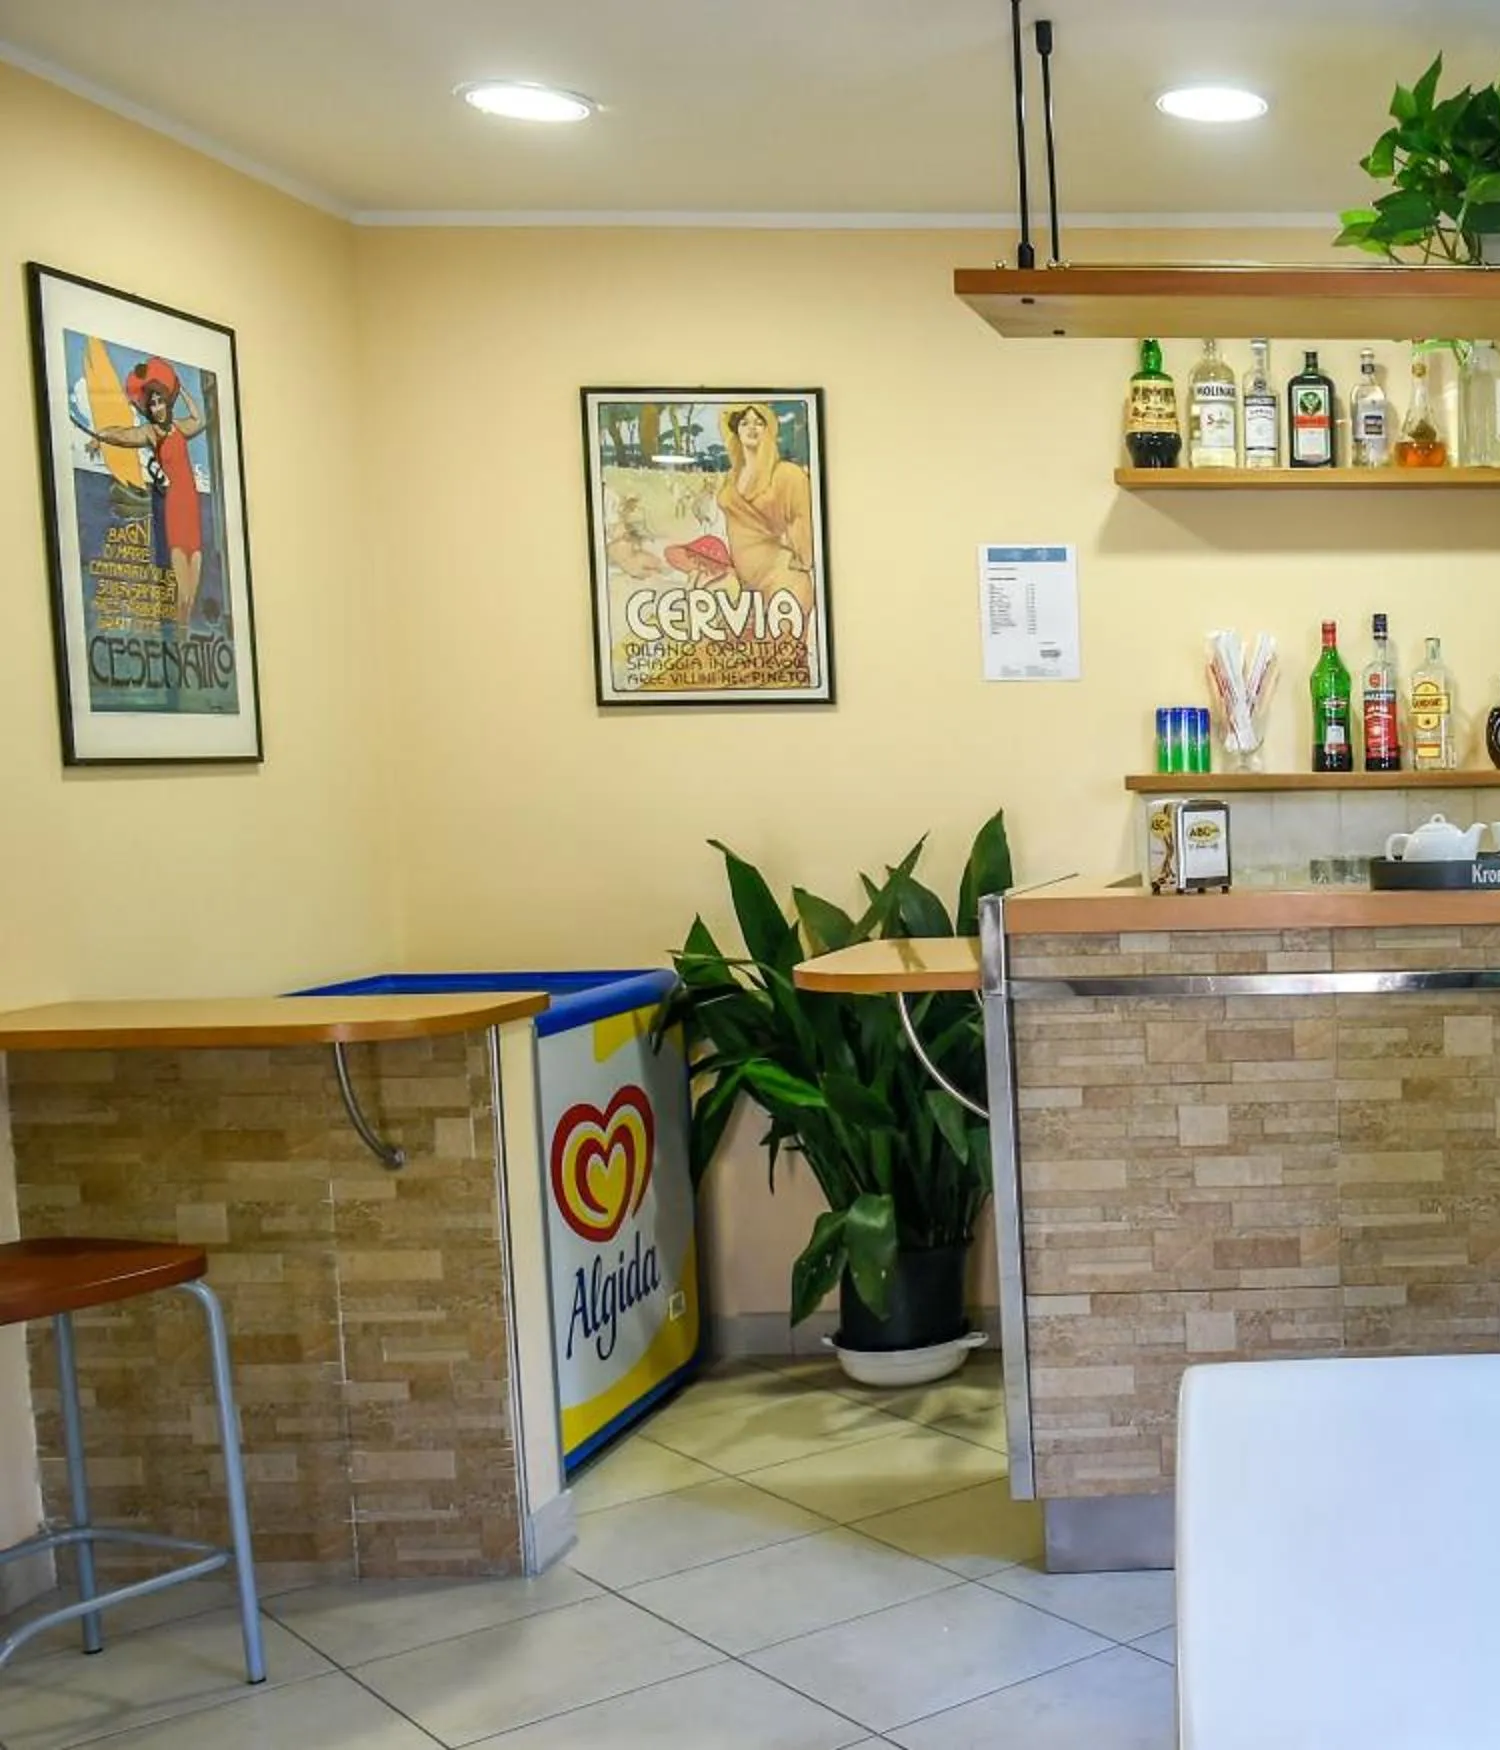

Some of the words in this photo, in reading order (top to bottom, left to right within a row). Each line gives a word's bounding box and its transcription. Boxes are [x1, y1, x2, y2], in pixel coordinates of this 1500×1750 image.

[626, 588, 804, 642] CERVIA
[90, 632, 234, 690] CESENATICO
[626, 642, 696, 657] MILANO
[705, 641, 808, 656] MARITTIMA
[627, 657, 702, 671] SPIAGGIA
[1189, 825, 1211, 837] ABC
[566, 1230, 660, 1361] Algida
